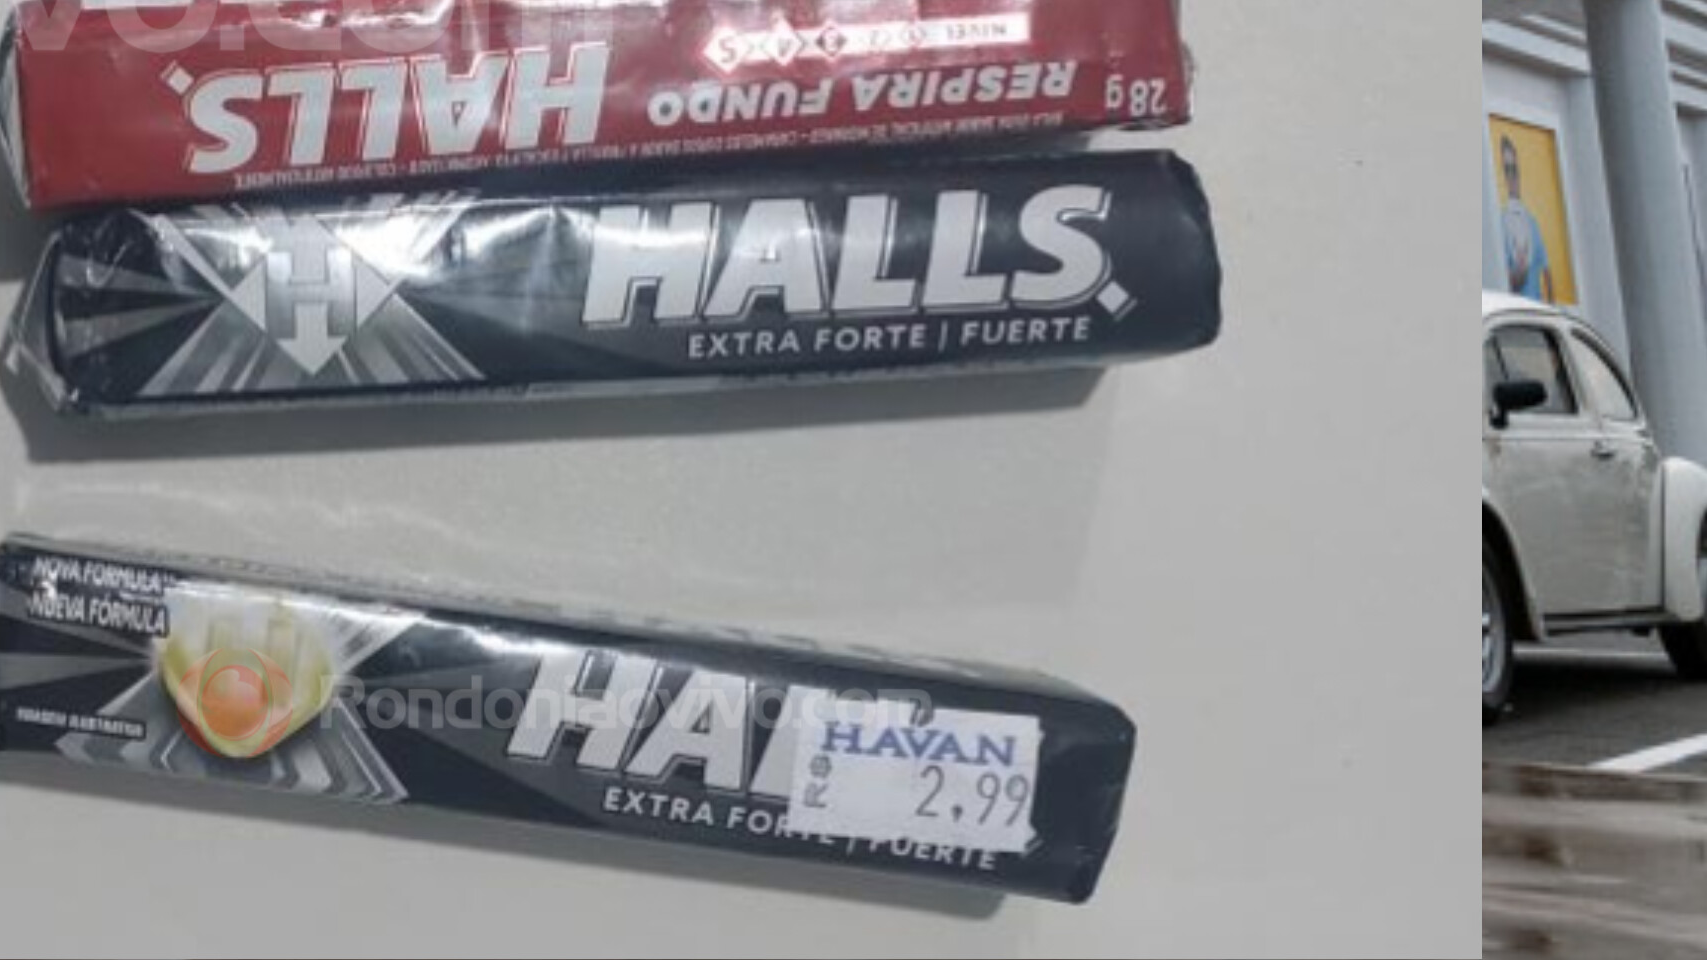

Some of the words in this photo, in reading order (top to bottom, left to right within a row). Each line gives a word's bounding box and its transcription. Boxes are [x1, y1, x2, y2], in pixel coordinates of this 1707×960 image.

[647, 77, 832, 126] FUNDO
[850, 60, 1076, 110] RESPIRA
[1127, 77, 1166, 117] 28
[688, 333, 799, 359] EXTRA
[813, 323, 926, 352] FORTE
[961, 316, 1091, 344] FUERTE
[820, 721, 1018, 766] HAVAN
[603, 786, 713, 826] EXTRA
